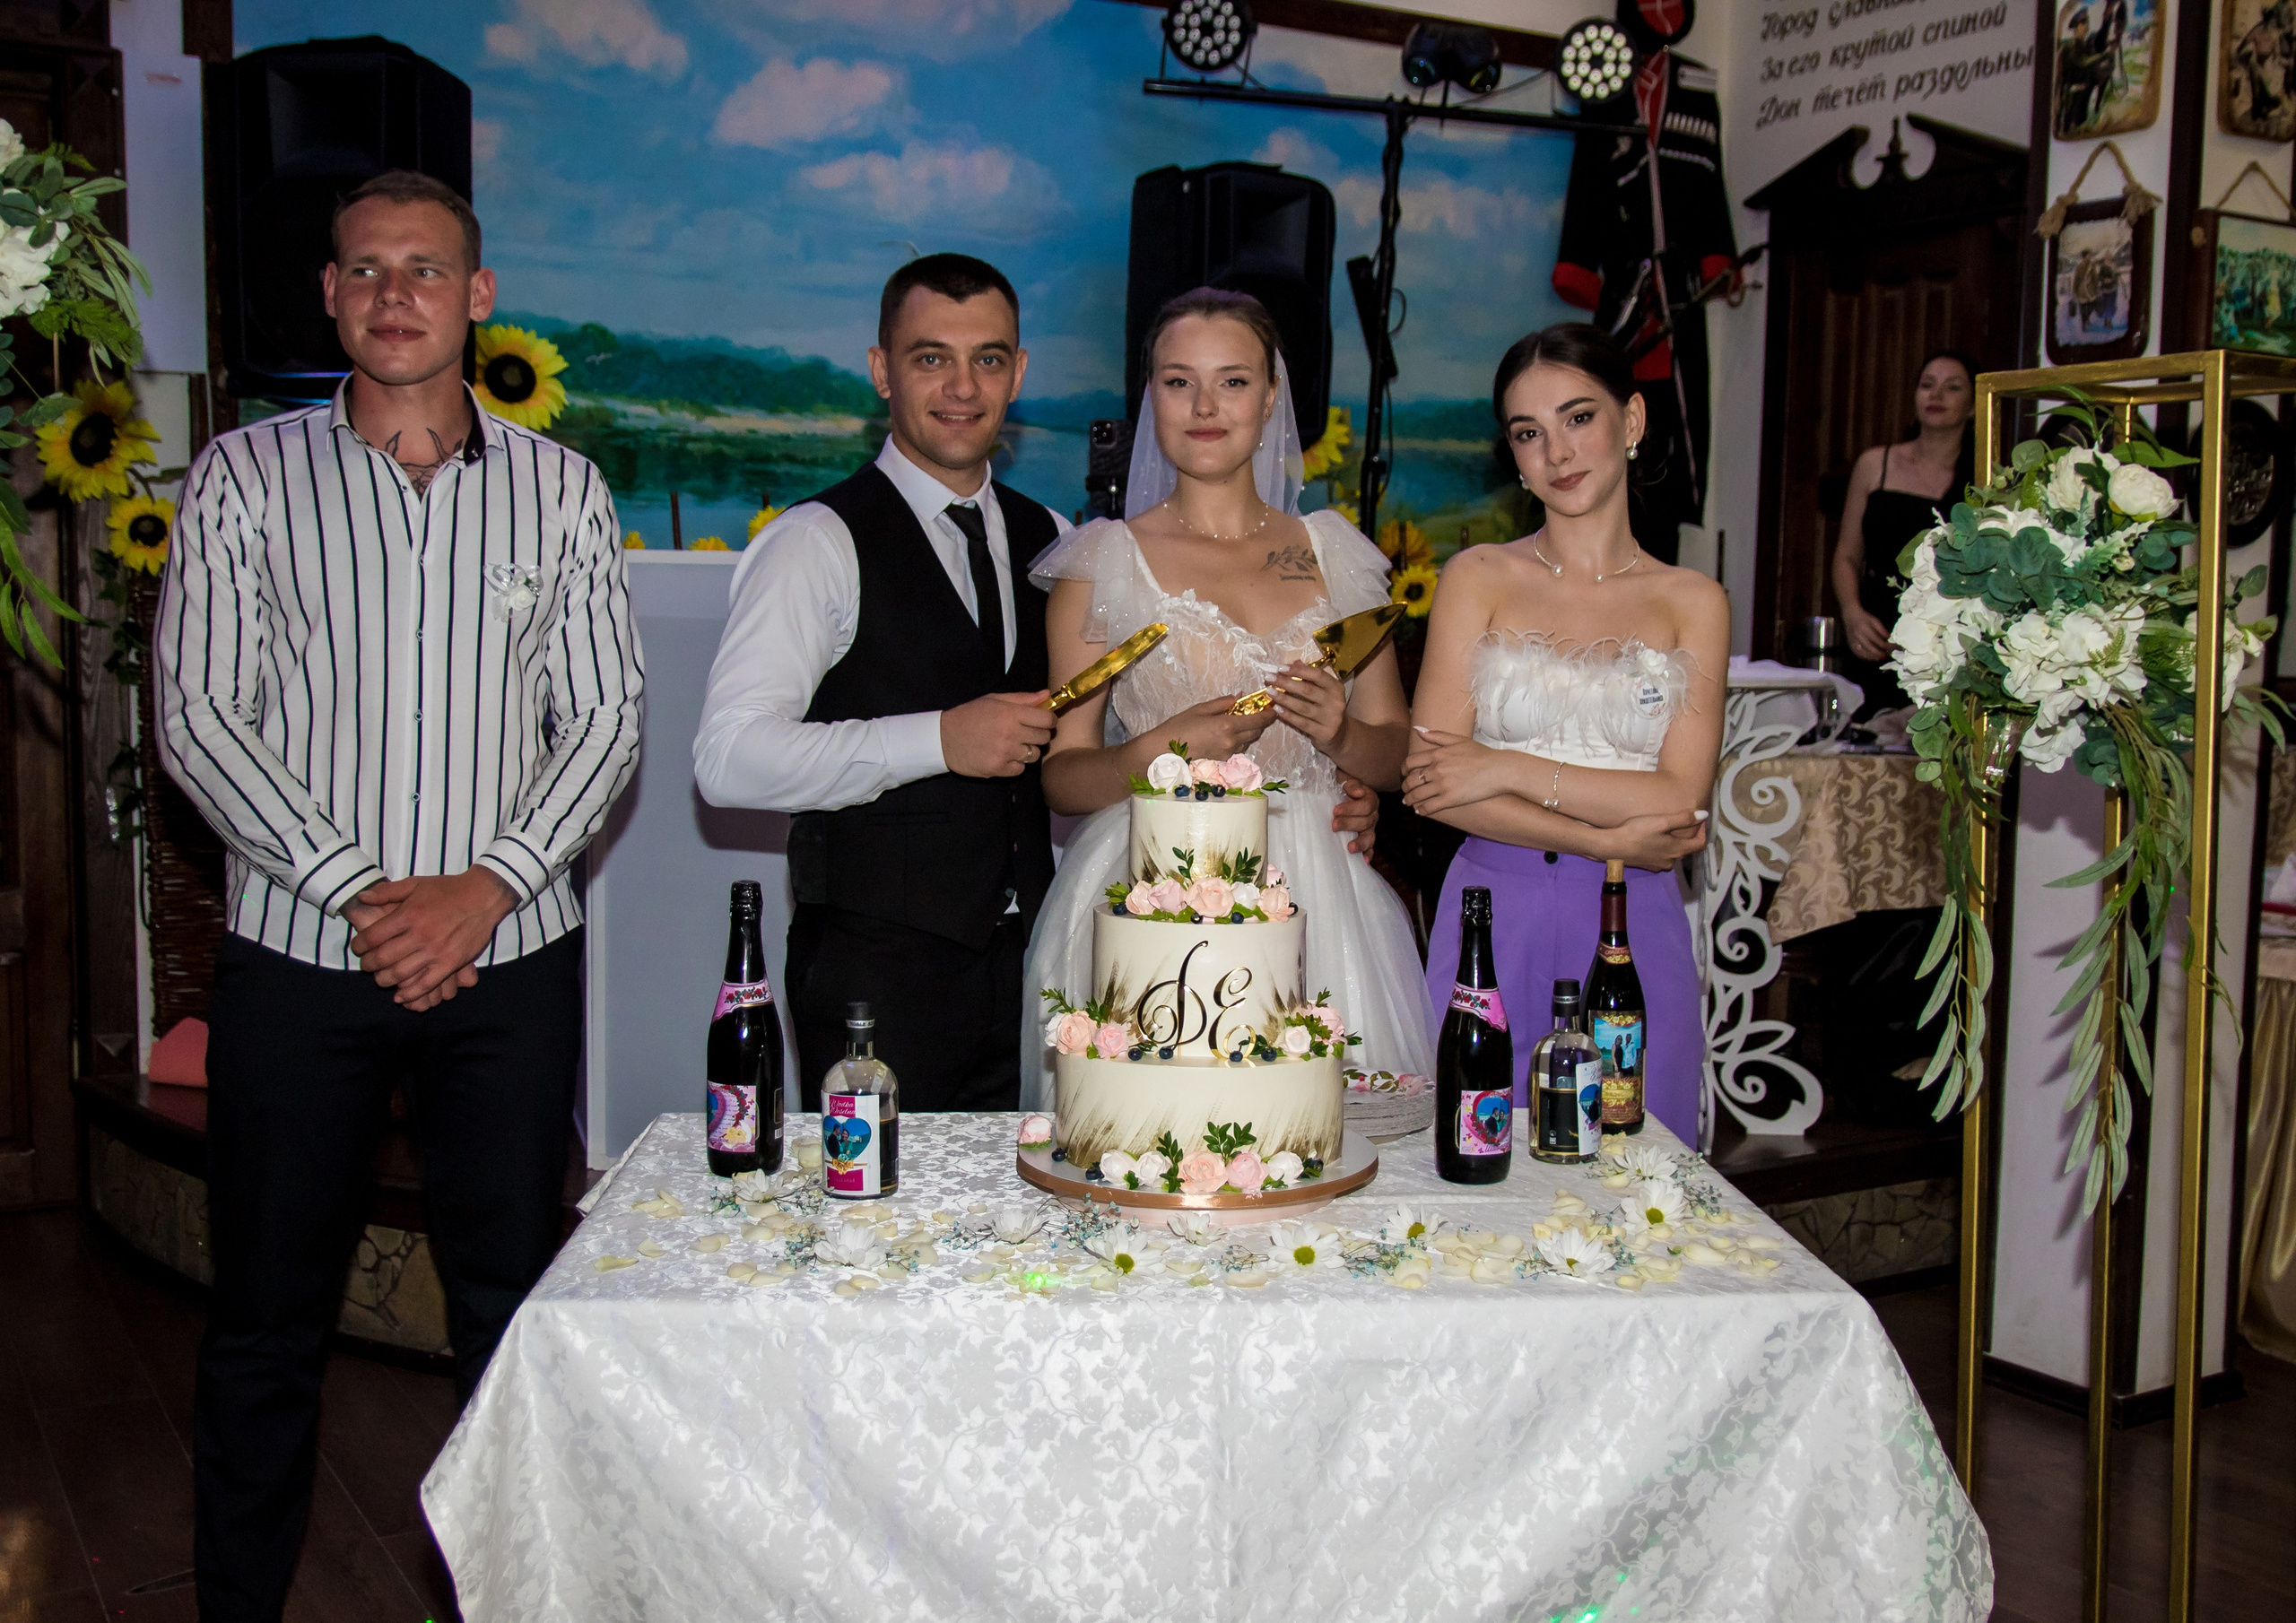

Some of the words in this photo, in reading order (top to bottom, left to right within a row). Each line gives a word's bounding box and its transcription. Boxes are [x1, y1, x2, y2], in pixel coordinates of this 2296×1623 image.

[1786, 49, 1822, 79] его
[1829, 22, 1916, 71] крутой
[1922, 1, 2008, 45] спиной
[1755, 94, 1802, 131] Дон
[1892, 45, 2034, 103] раздольны
